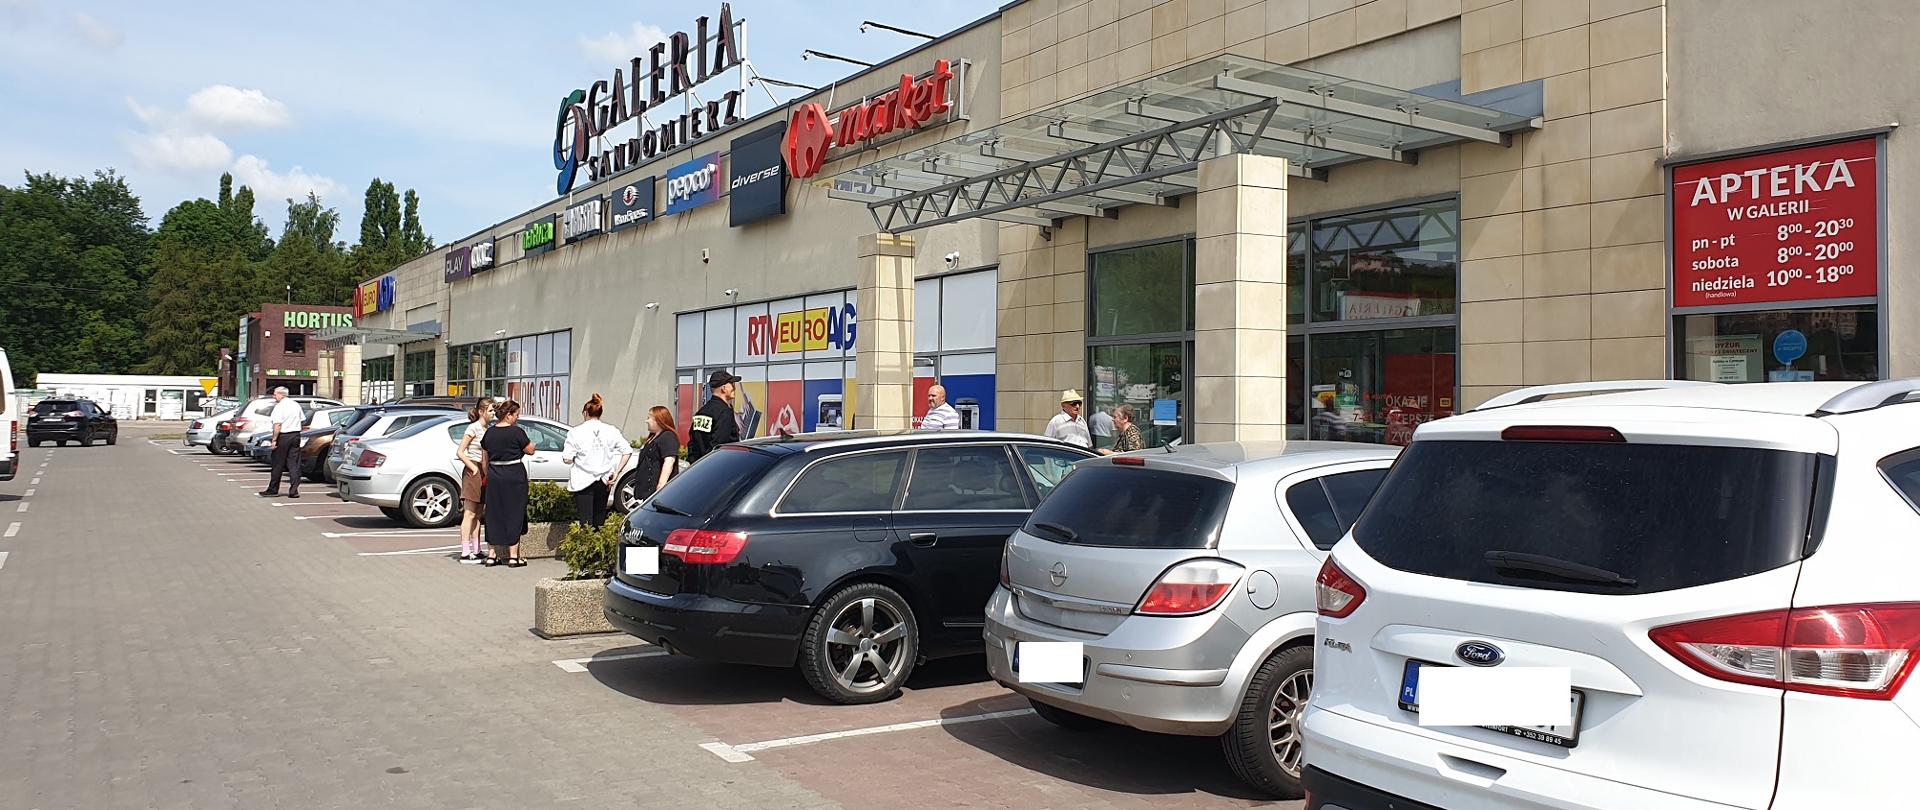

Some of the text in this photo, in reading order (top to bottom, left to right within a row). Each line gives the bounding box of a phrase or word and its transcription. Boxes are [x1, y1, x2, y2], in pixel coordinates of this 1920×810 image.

[587, 2, 740, 136] GALERIA
[838, 59, 953, 147] market
[589, 91, 738, 181] SANDOMIERZ
[668, 167, 712, 205] pepco
[731, 164, 780, 190] diverse
[1690, 158, 1855, 206] APTEKA
[1727, 200, 1809, 220] W GALERII
[1692, 237, 1709, 251] pn
[1721, 233, 1736, 249] pt
[446, 255, 464, 274] PLAY
[1692, 256, 1739, 271] sobota
[1692, 275, 1755, 292] niedziela
[1705, 291, 1737, 299] (handlowa)
[284, 311, 353, 328] HORTUS
[747, 303, 857, 356] RTV EURO AG
[1463, 645, 1491, 661] Ford
[1404, 686, 1414, 698] PL
[1537, 733, 1545, 741] 39
[1545, 735, 1553, 743] 89
[1554, 737, 1562, 745] 45
